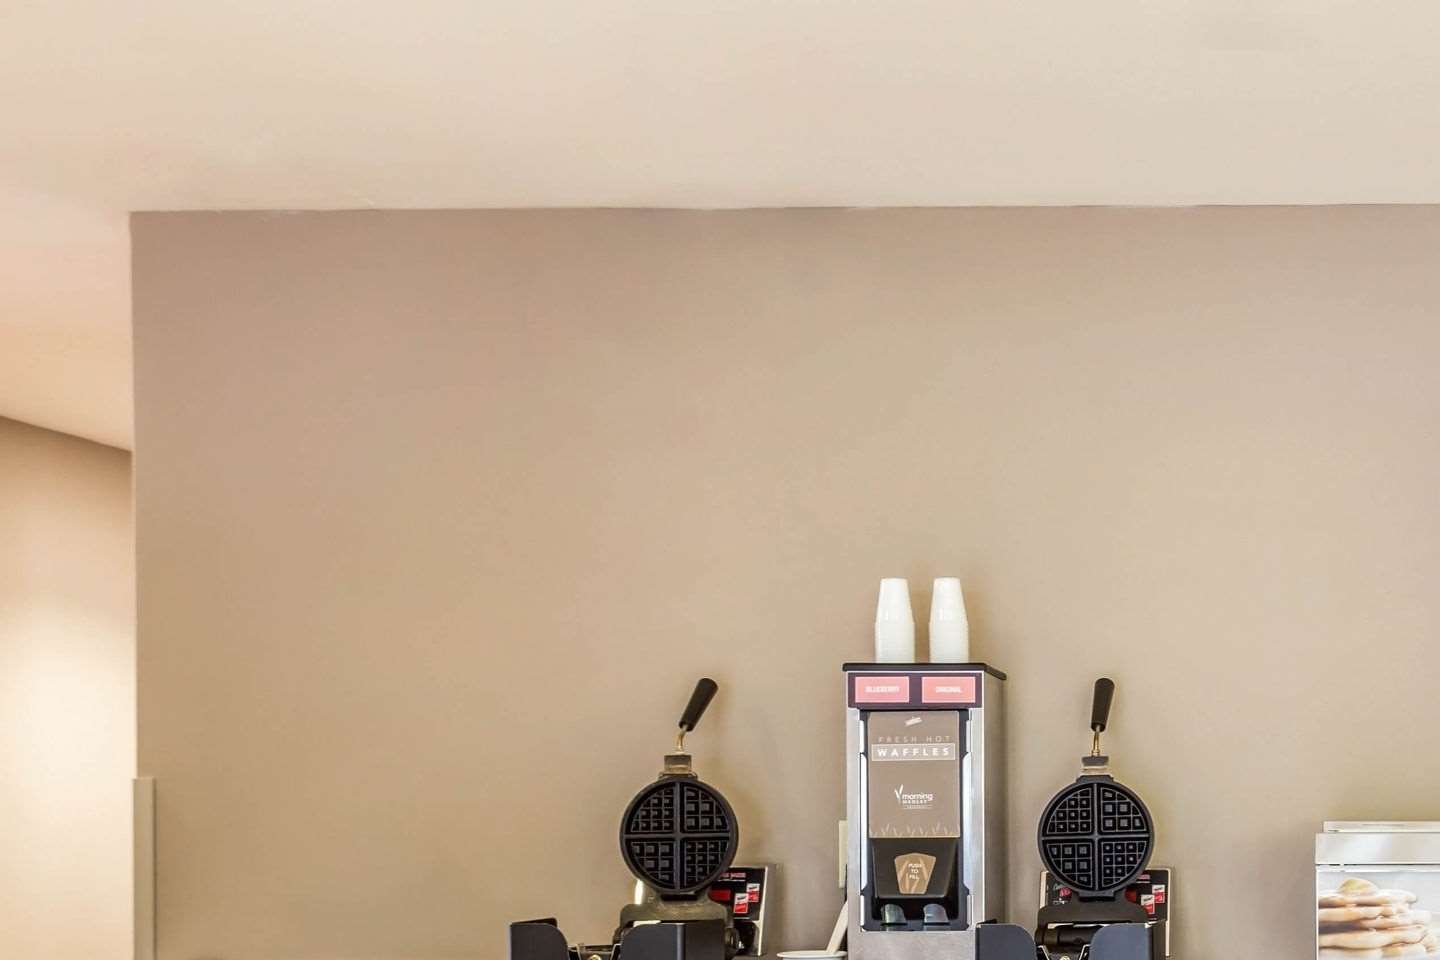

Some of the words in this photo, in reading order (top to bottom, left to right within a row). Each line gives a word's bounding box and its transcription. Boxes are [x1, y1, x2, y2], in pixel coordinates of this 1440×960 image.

[878, 735, 917, 743] FRESH
[926, 735, 951, 743] HOT
[877, 747, 950, 757] WAFFLES
[902, 793, 933, 802] morning
